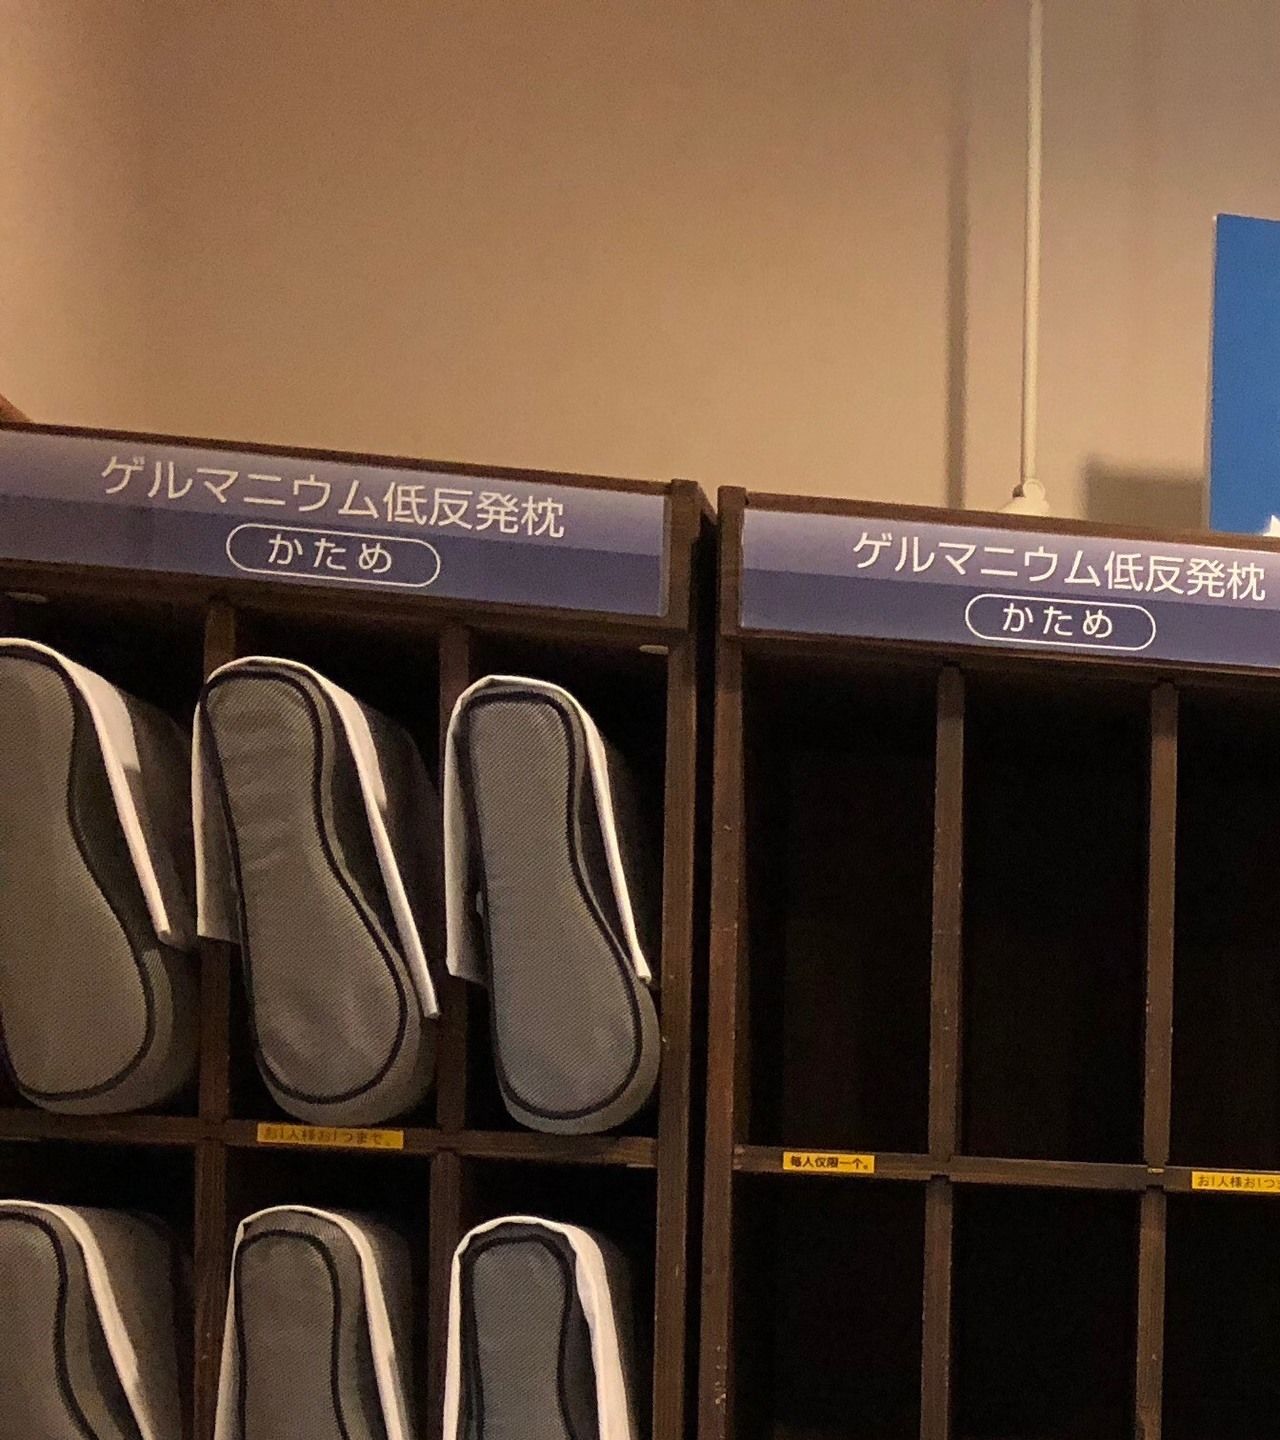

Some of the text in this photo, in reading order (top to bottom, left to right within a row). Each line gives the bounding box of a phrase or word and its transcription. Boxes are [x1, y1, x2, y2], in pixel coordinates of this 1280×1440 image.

[100, 454, 566, 539] ゲルマニウム低反発枕
[267, 533, 393, 574] かため
[851, 531, 1266, 601] ゲルマニウム低反発枕
[1002, 603, 1114, 639] かため
